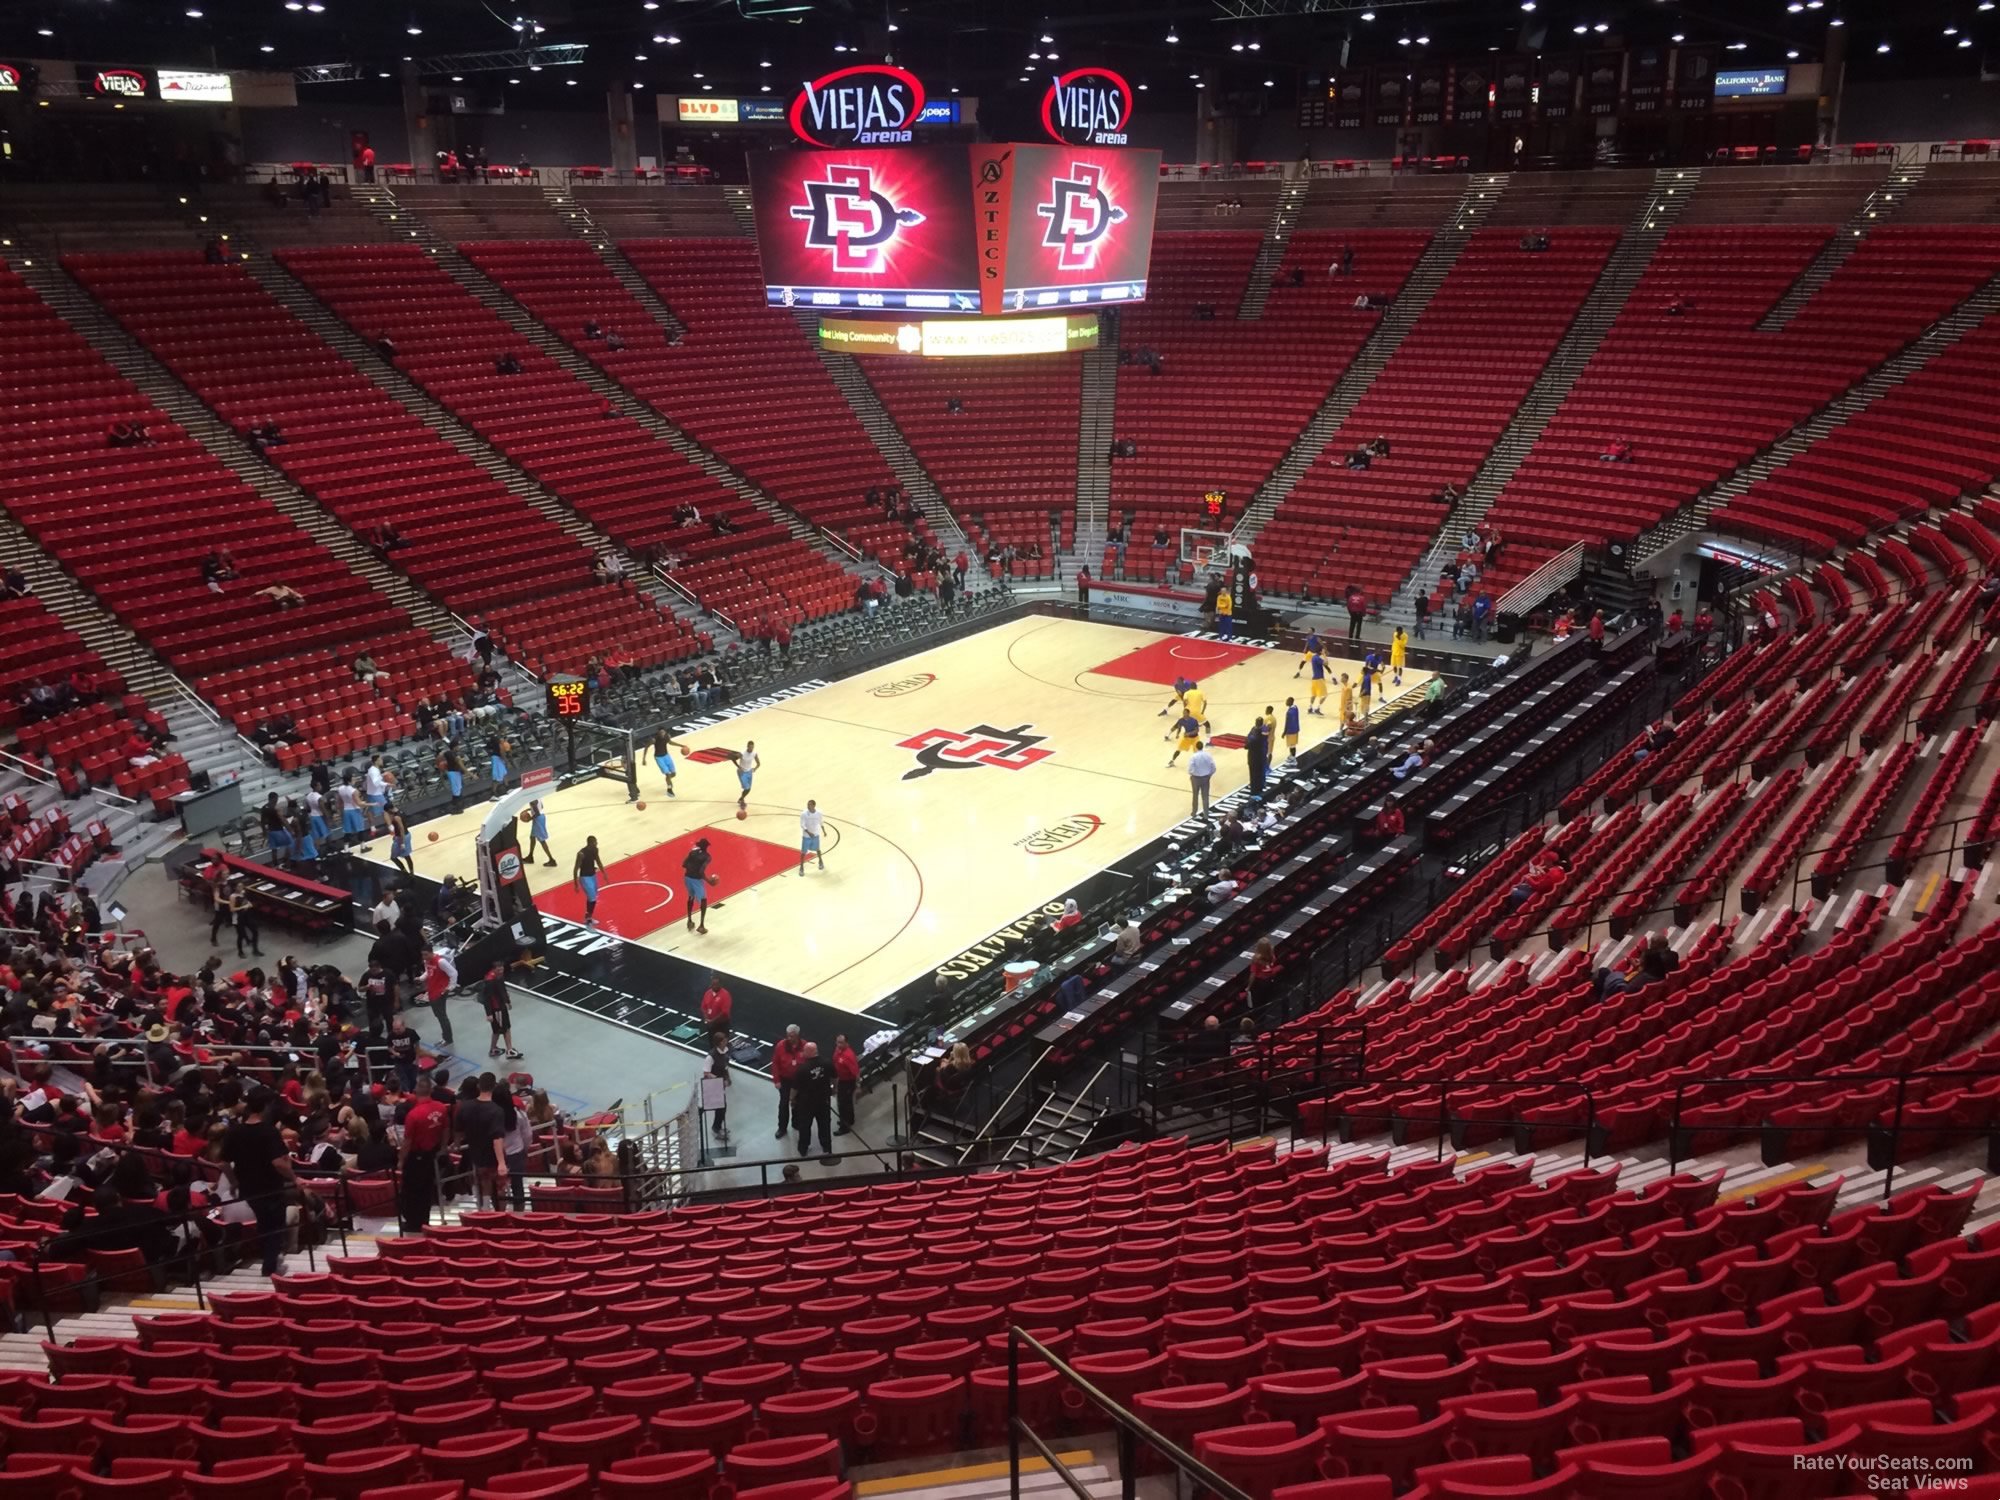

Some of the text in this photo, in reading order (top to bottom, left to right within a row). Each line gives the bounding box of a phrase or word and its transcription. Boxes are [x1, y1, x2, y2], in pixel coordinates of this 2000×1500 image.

[98, 73, 140, 95] VIEJAS
[1715, 77, 1759, 85] CALIFORNIA
[1764, 75, 1785, 83] BANK
[680, 103, 719, 113] BLVD
[803, 81, 903, 142] VIEJAS
[927, 108, 951, 117] peps
[1053, 76, 1119, 141] VIEJAS
[1635, 102, 1655, 110] 2011
[861, 129, 912, 144] arena
[1095, 132, 1128, 144] arena
[982, 162, 1000, 279] AZTECS
[1183, 630, 1281, 648] AZECS
[551, 683, 585, 697] 56:22
[877, 677, 940, 695] VIEJAS
[558, 695, 581, 714] 35
[671, 678, 834, 734] SAN DIEGO STATE
[1028, 819, 1107, 850] VIEJAS
